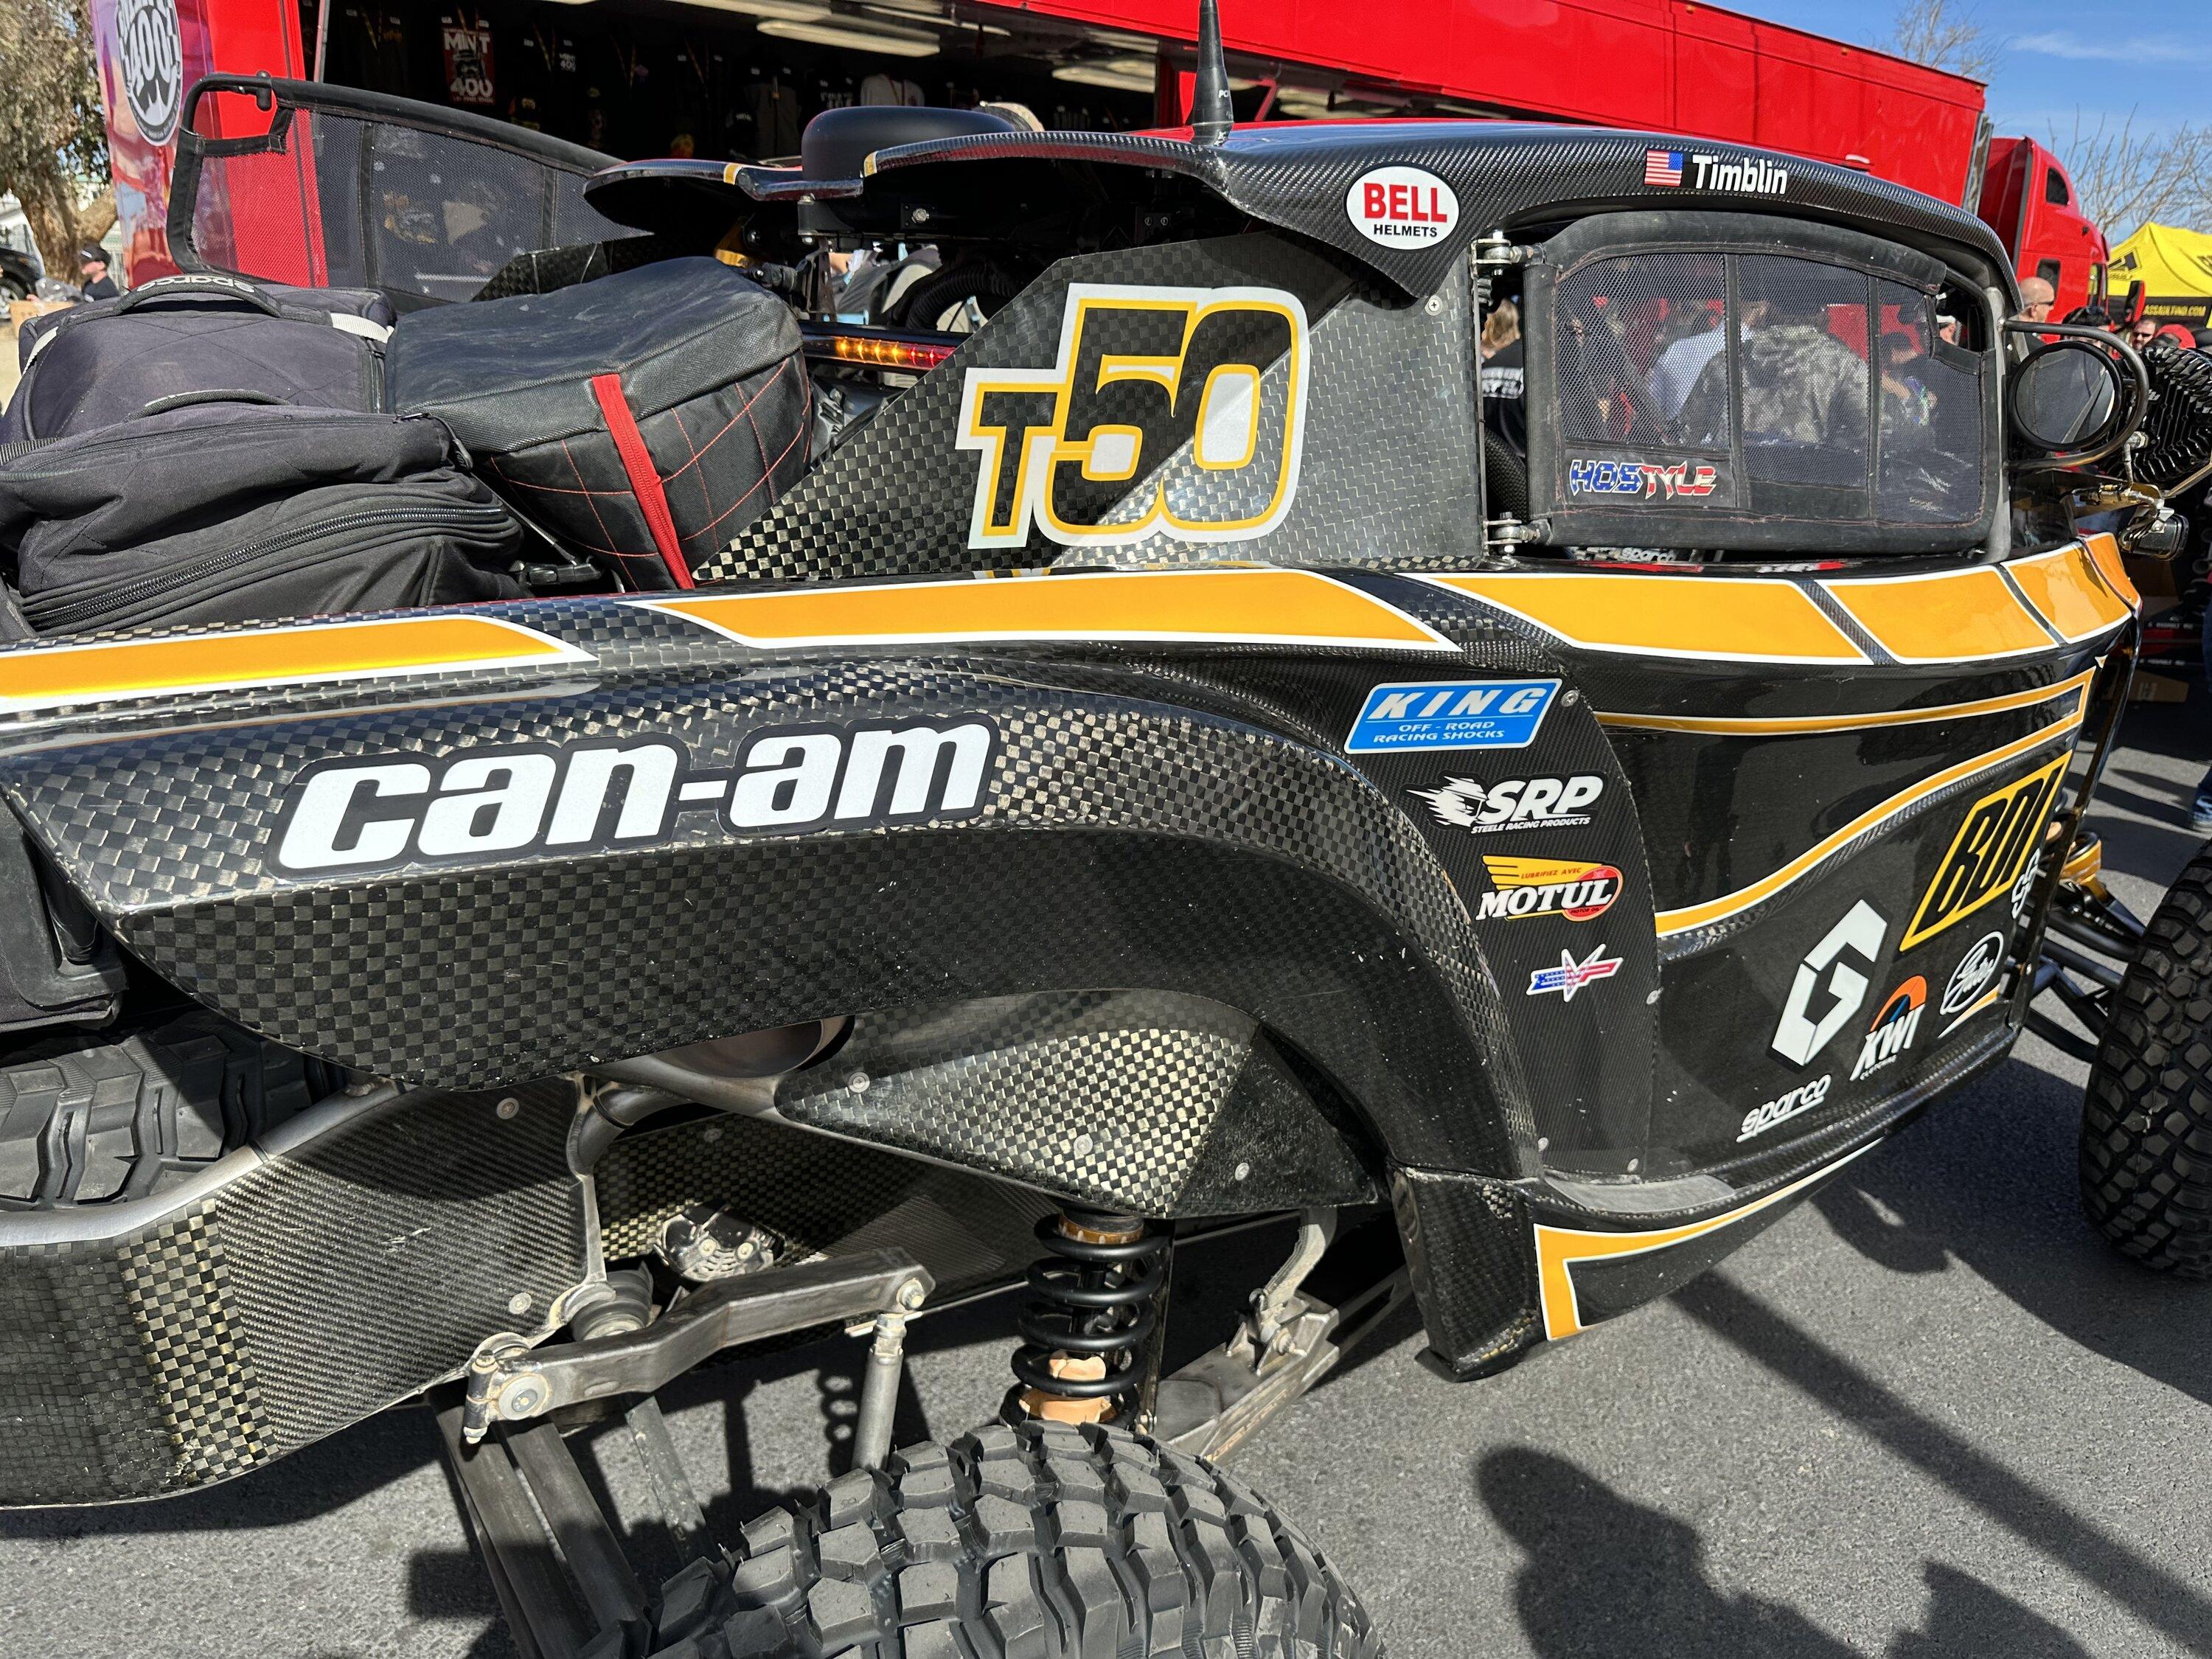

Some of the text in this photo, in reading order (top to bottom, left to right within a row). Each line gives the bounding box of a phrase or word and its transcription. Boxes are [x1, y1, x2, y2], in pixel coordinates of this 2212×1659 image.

[129, 9, 171, 97] 400
[450, 76, 493, 97] 400
[1692, 154, 1788, 194] Timblin
[1364, 182, 1447, 223] BELL
[1374, 224, 1438, 237] HELMETS
[956, 283, 1310, 549] T50
[1569, 459, 1717, 500] HOSTYLE
[1367, 687, 1548, 720] KING
[1373, 730, 1505, 743] RACING SHOCKS
[1399, 723, 1433, 732] OFF
[1444, 721, 1495, 731] ROAD
[279, 723, 990, 869] can-am
[1475, 776, 1604, 825] SRP
[1471, 817, 1591, 834] STEELE RACING PRODUCTS
[1520, 867, 1582, 880] LUBRIFIEZ AVEC
[1475, 879, 1613, 921] MOTUL
[1741, 1074, 1832, 1137] sparco
